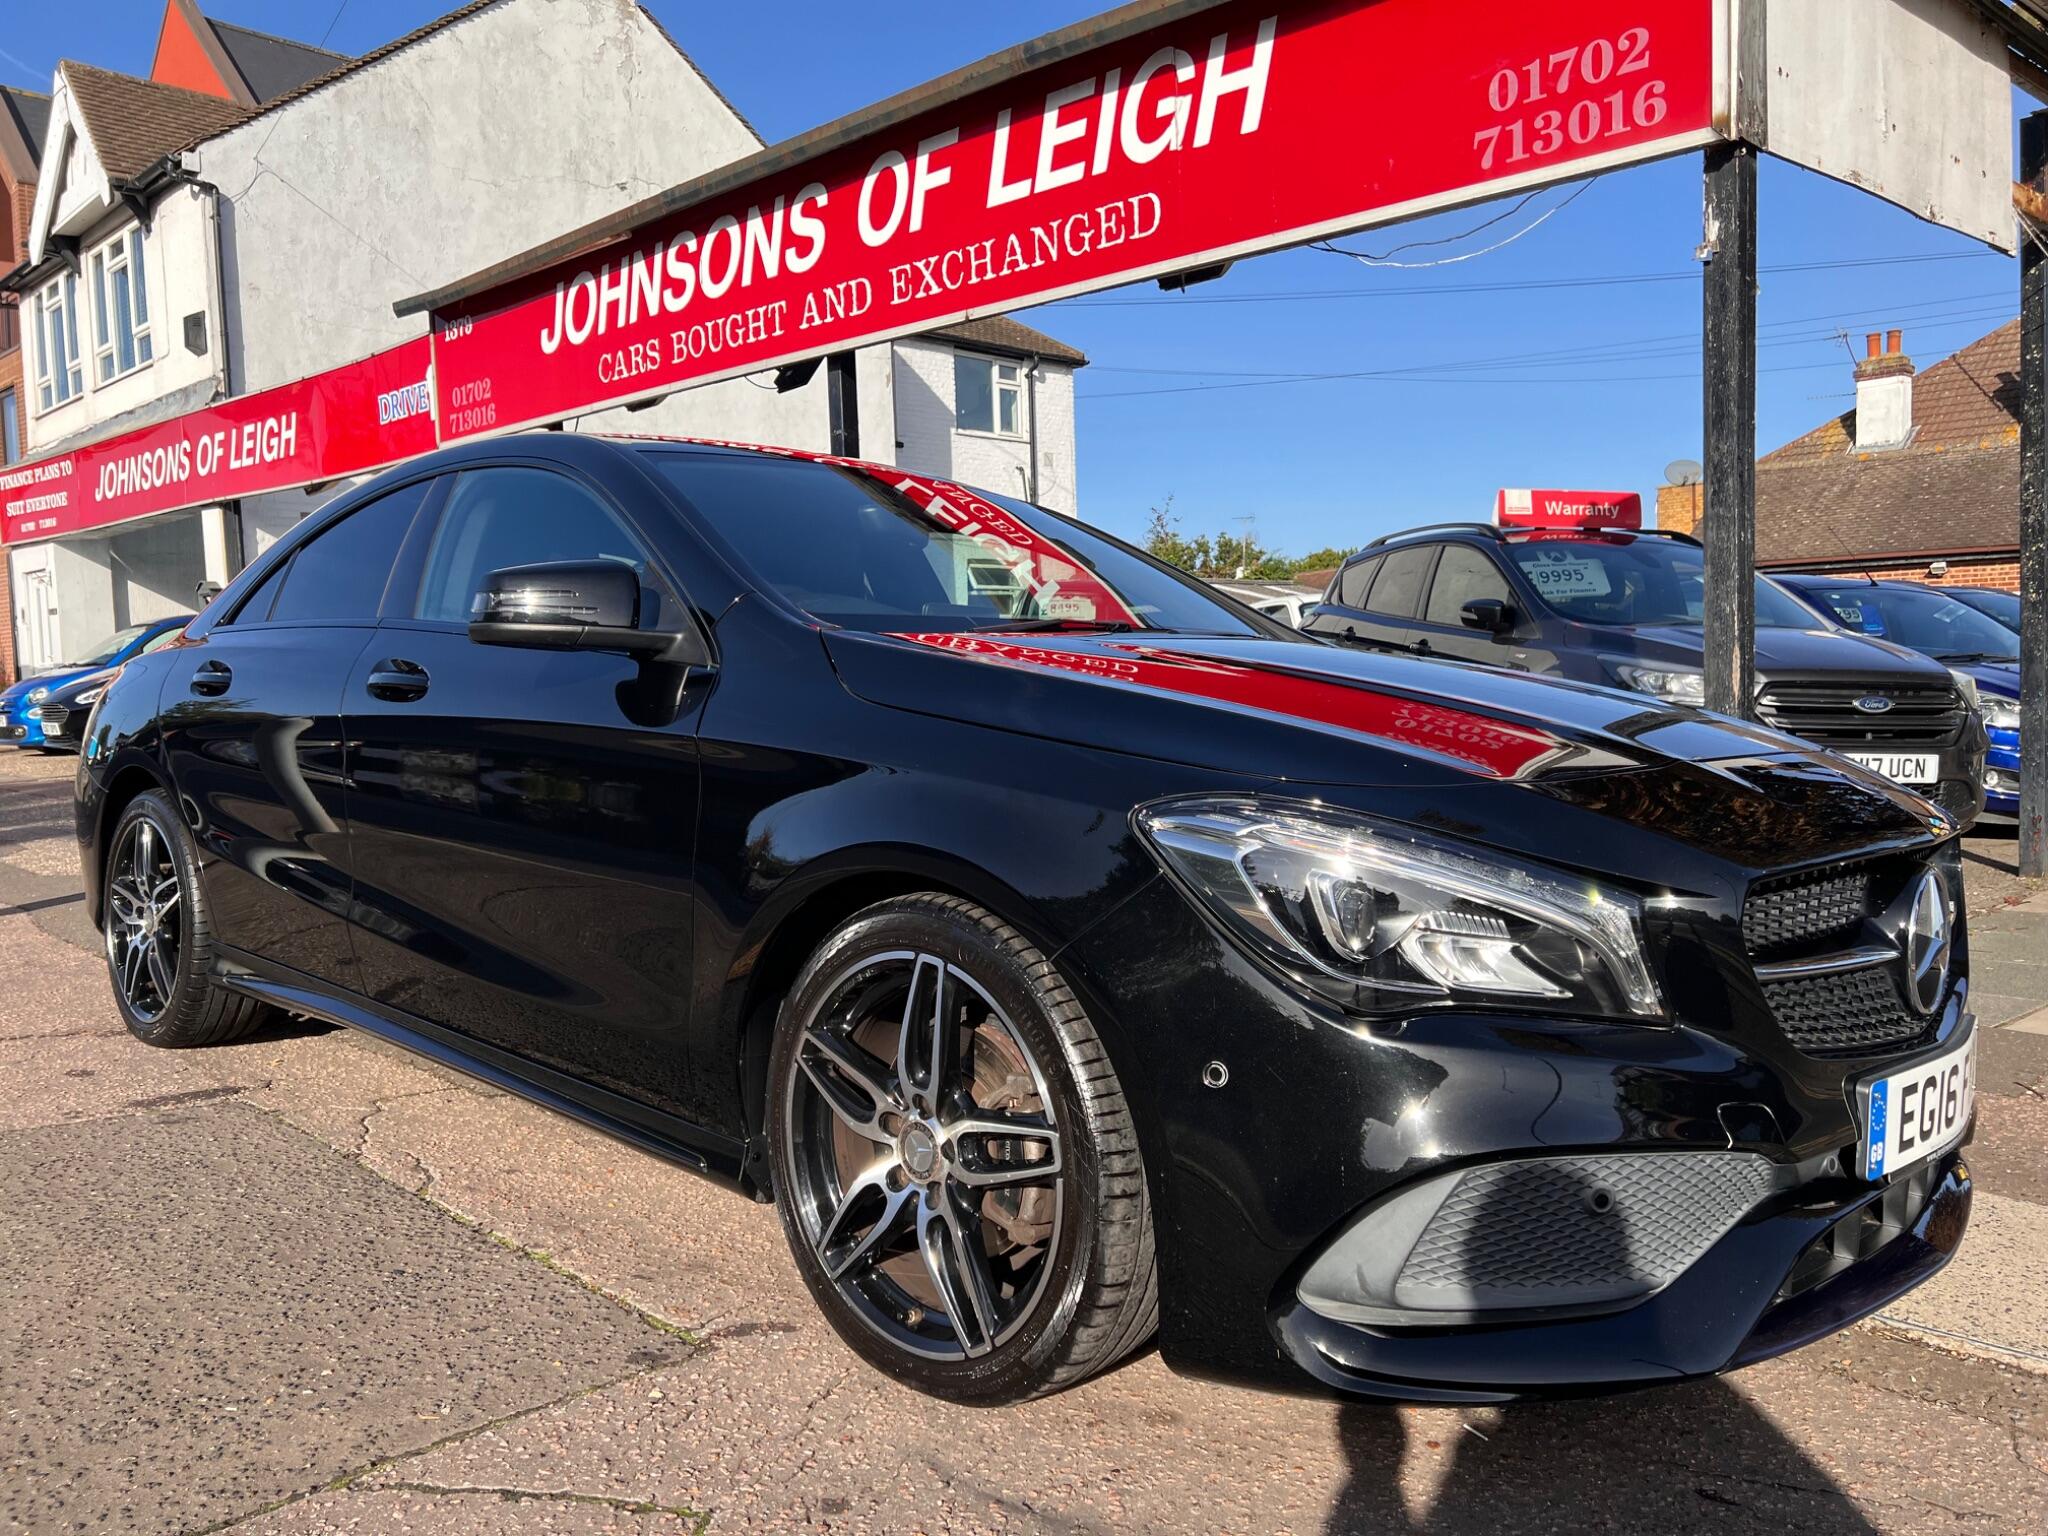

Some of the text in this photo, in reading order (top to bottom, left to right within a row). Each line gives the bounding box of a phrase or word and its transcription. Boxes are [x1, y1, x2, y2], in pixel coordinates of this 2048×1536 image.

[1488, 27, 1650, 113] 01702
[1473, 80, 1668, 170] 713016
[540, 15, 1278, 355] JOHNSONS OF LEIGH
[598, 192, 1162, 383] CARS BOUGHT AND EXCHANGED
[378, 380, 430, 425] DRIVE
[452, 377, 492, 408] 01702
[449, 402, 497, 434] 713016
[95, 411, 297, 502] JOHNSONS OF LEIGH
[0, 460, 73, 491] FINANCE PLANS TO
[6, 491, 68, 517] SUIT EVERYONE
[1544, 500, 1620, 519] Warranty
[1864, 699, 1885, 708] Ford
[1889, 758, 1926, 778] UCN
[1899, 1063, 1959, 1154] EG16
[1870, 1141, 1883, 1163] GB
